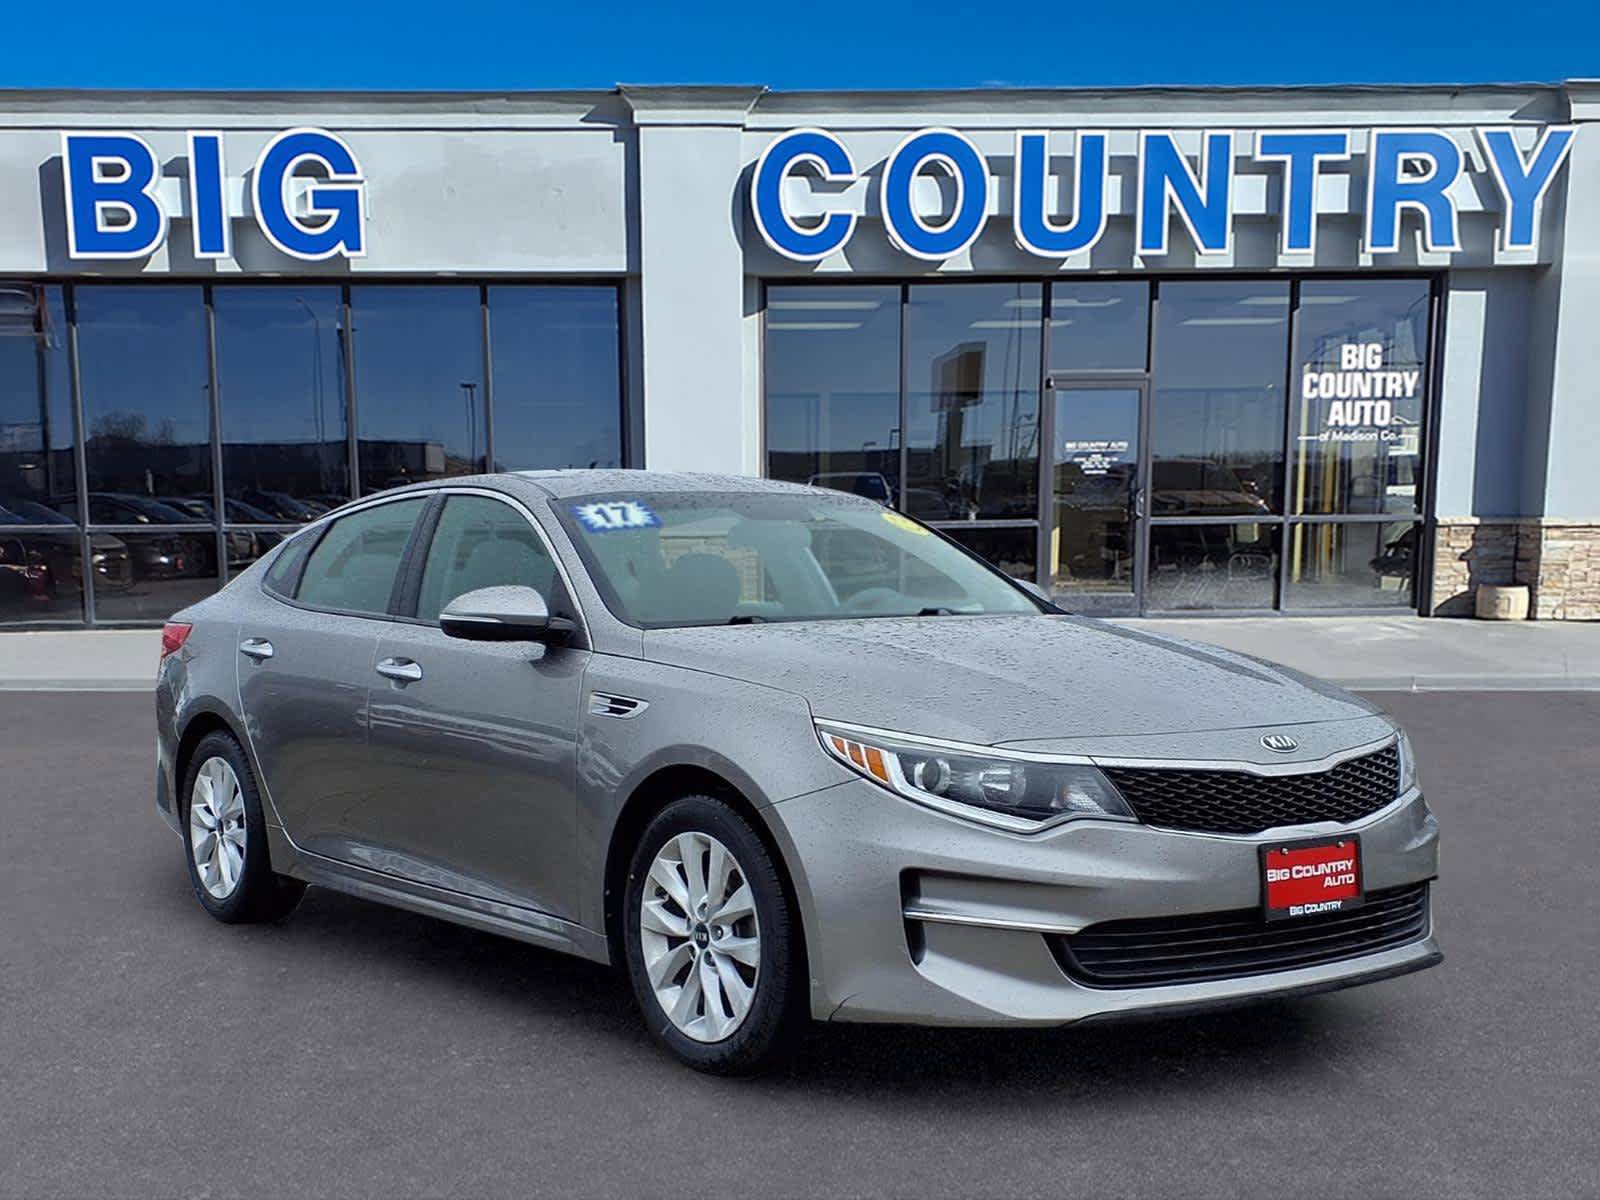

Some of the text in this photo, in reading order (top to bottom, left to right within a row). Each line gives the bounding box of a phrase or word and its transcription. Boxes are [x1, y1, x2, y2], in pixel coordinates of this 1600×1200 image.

[60, 125, 1577, 262] BIG COUNTRY
[1341, 343, 1382, 370] BIG
[1303, 371, 1419, 399] COUNTRY
[1327, 400, 1391, 427] AUTO
[1319, 429, 1330, 442] of
[1331, 430, 1378, 441] Madison
[1264, 735, 1298, 748] KIA
[1267, 860, 1353, 881] BIG COUNTRY
[1323, 874, 1355, 887] AUTO
[1289, 901, 1342, 916] BIG COUNTRY
